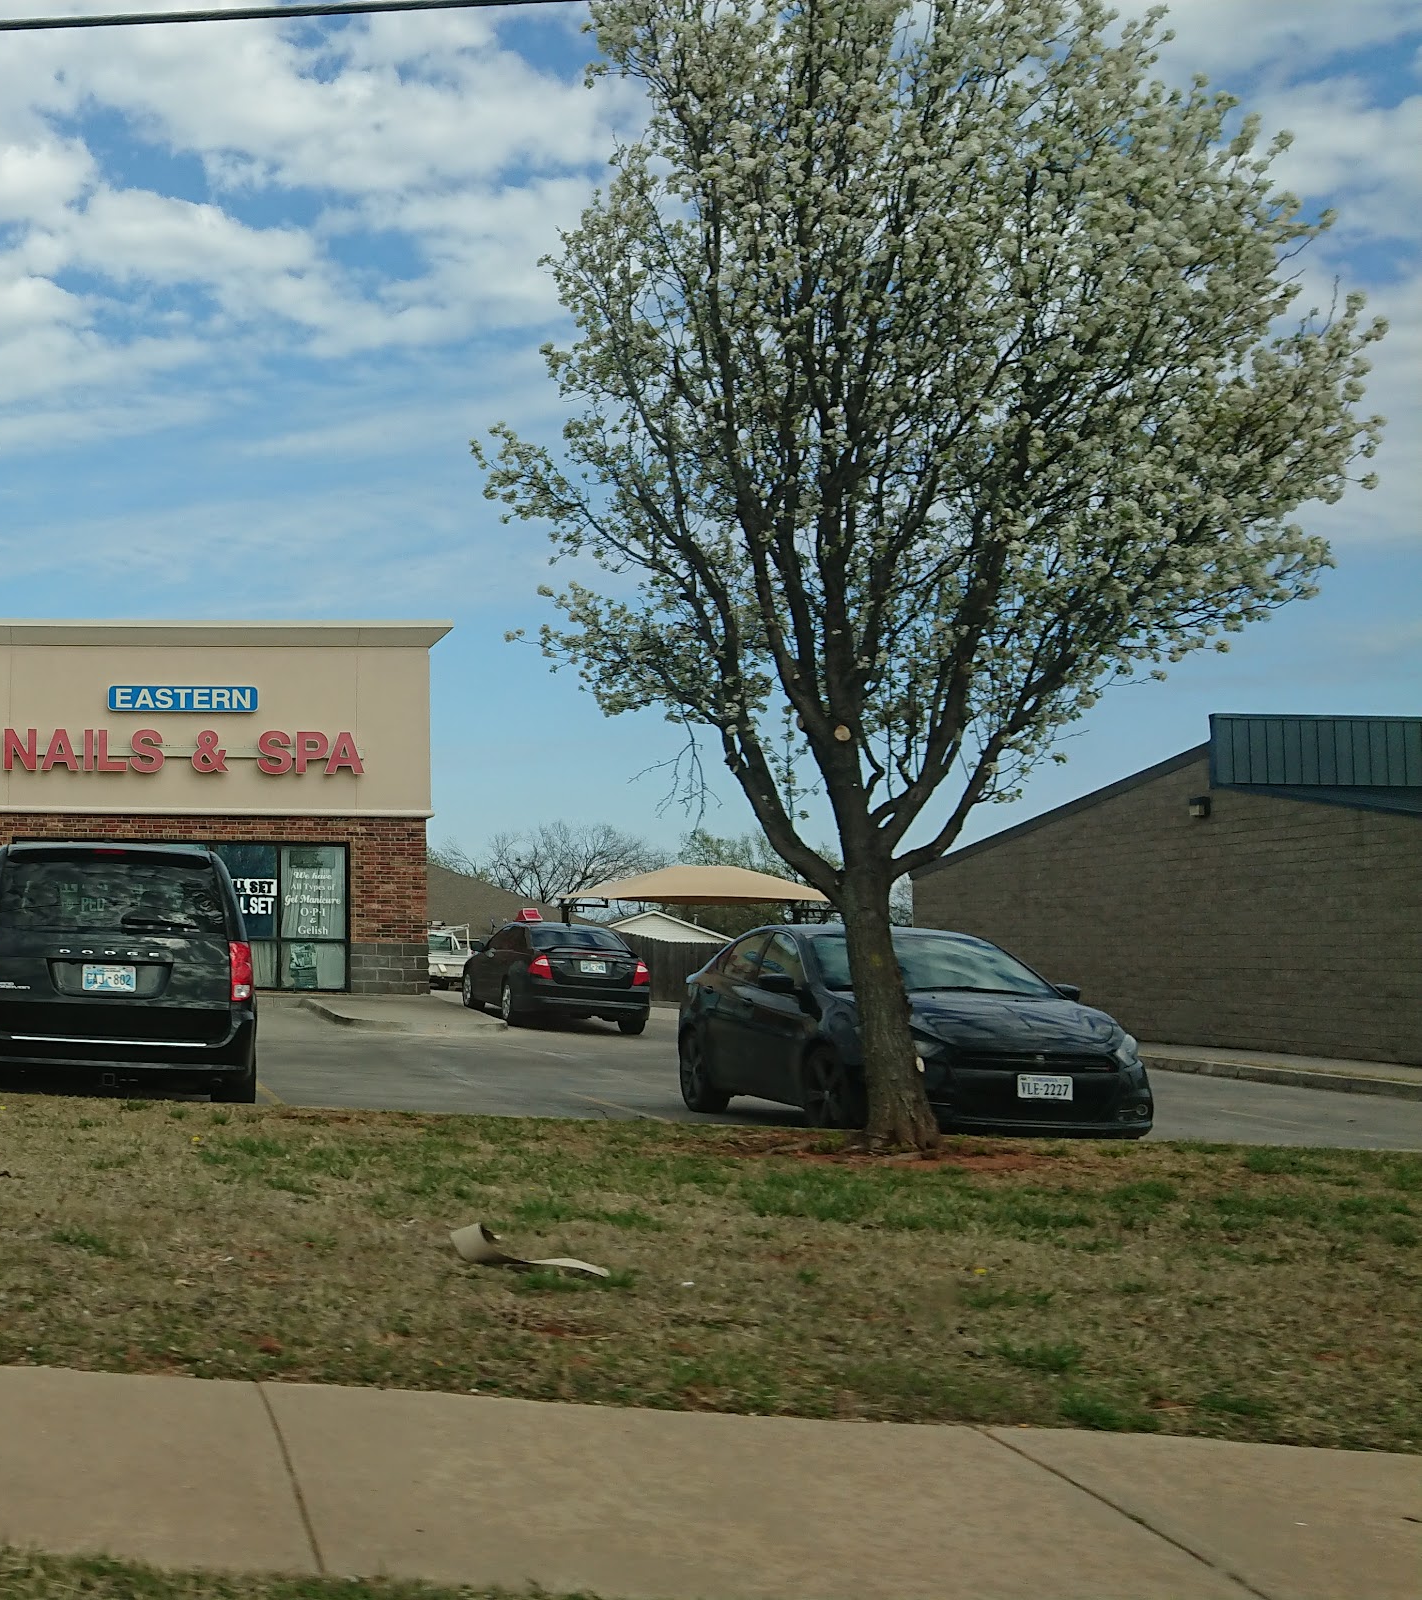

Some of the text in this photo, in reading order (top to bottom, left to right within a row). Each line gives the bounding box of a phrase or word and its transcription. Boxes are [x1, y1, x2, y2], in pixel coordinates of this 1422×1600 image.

[115, 688, 252, 709] EASTERN
[2, 727, 366, 775] NAILS & SPA
[293, 871, 332, 880] We have
[249, 880, 274, 894] SET
[290, 882, 336, 892] All Types of
[239, 896, 275, 915] L SET
[284, 895, 341, 906] Gel Manicure
[297, 925, 329, 935] Gelish
[59, 948, 160, 957] DODGE
[1021, 1082, 1070, 1097] VLE-2227
